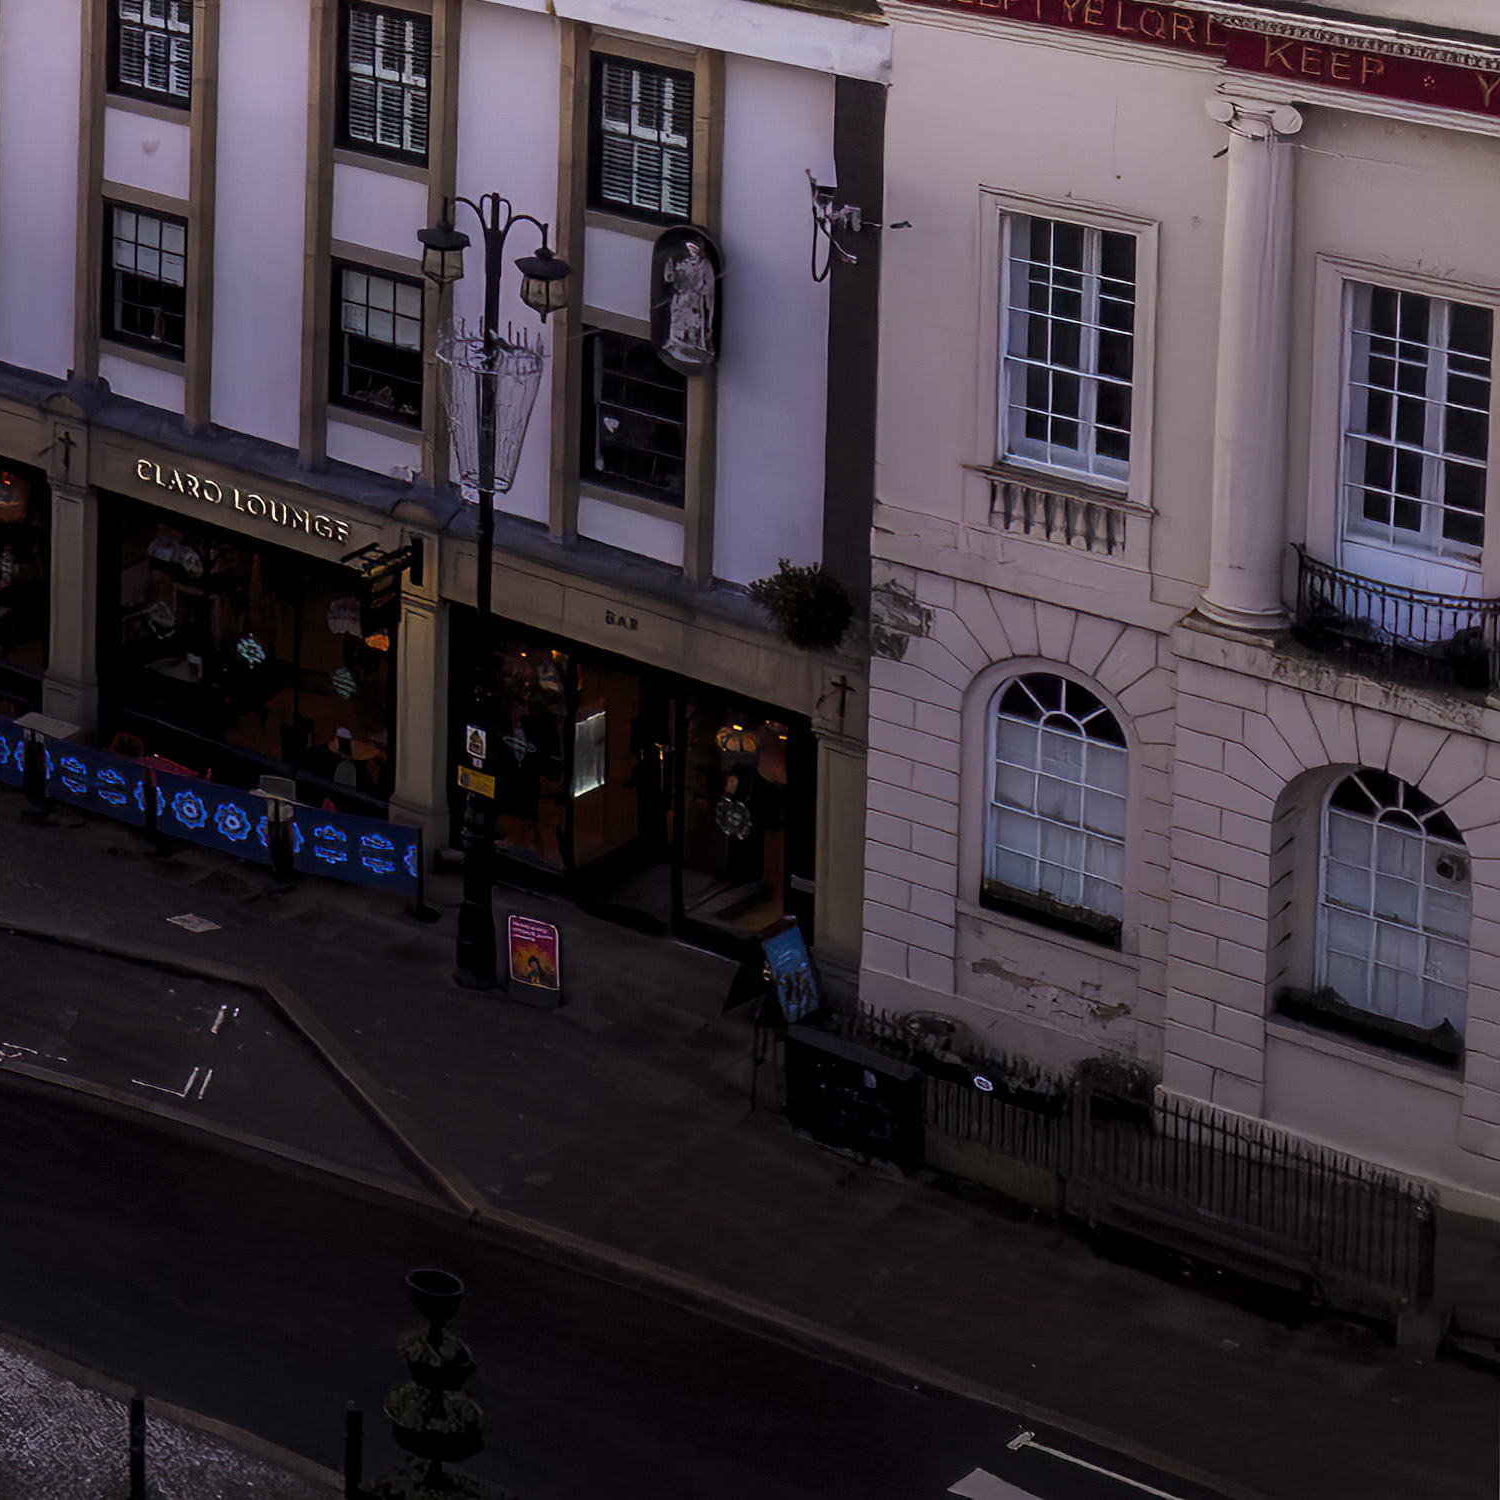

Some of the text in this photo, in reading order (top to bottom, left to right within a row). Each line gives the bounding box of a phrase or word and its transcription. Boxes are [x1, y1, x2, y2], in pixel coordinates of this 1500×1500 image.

[1264, 35, 1386, 85] KEEP
[136, 458, 349, 544] CLARO LOUNGE
[605, 610, 638, 630] BAR
